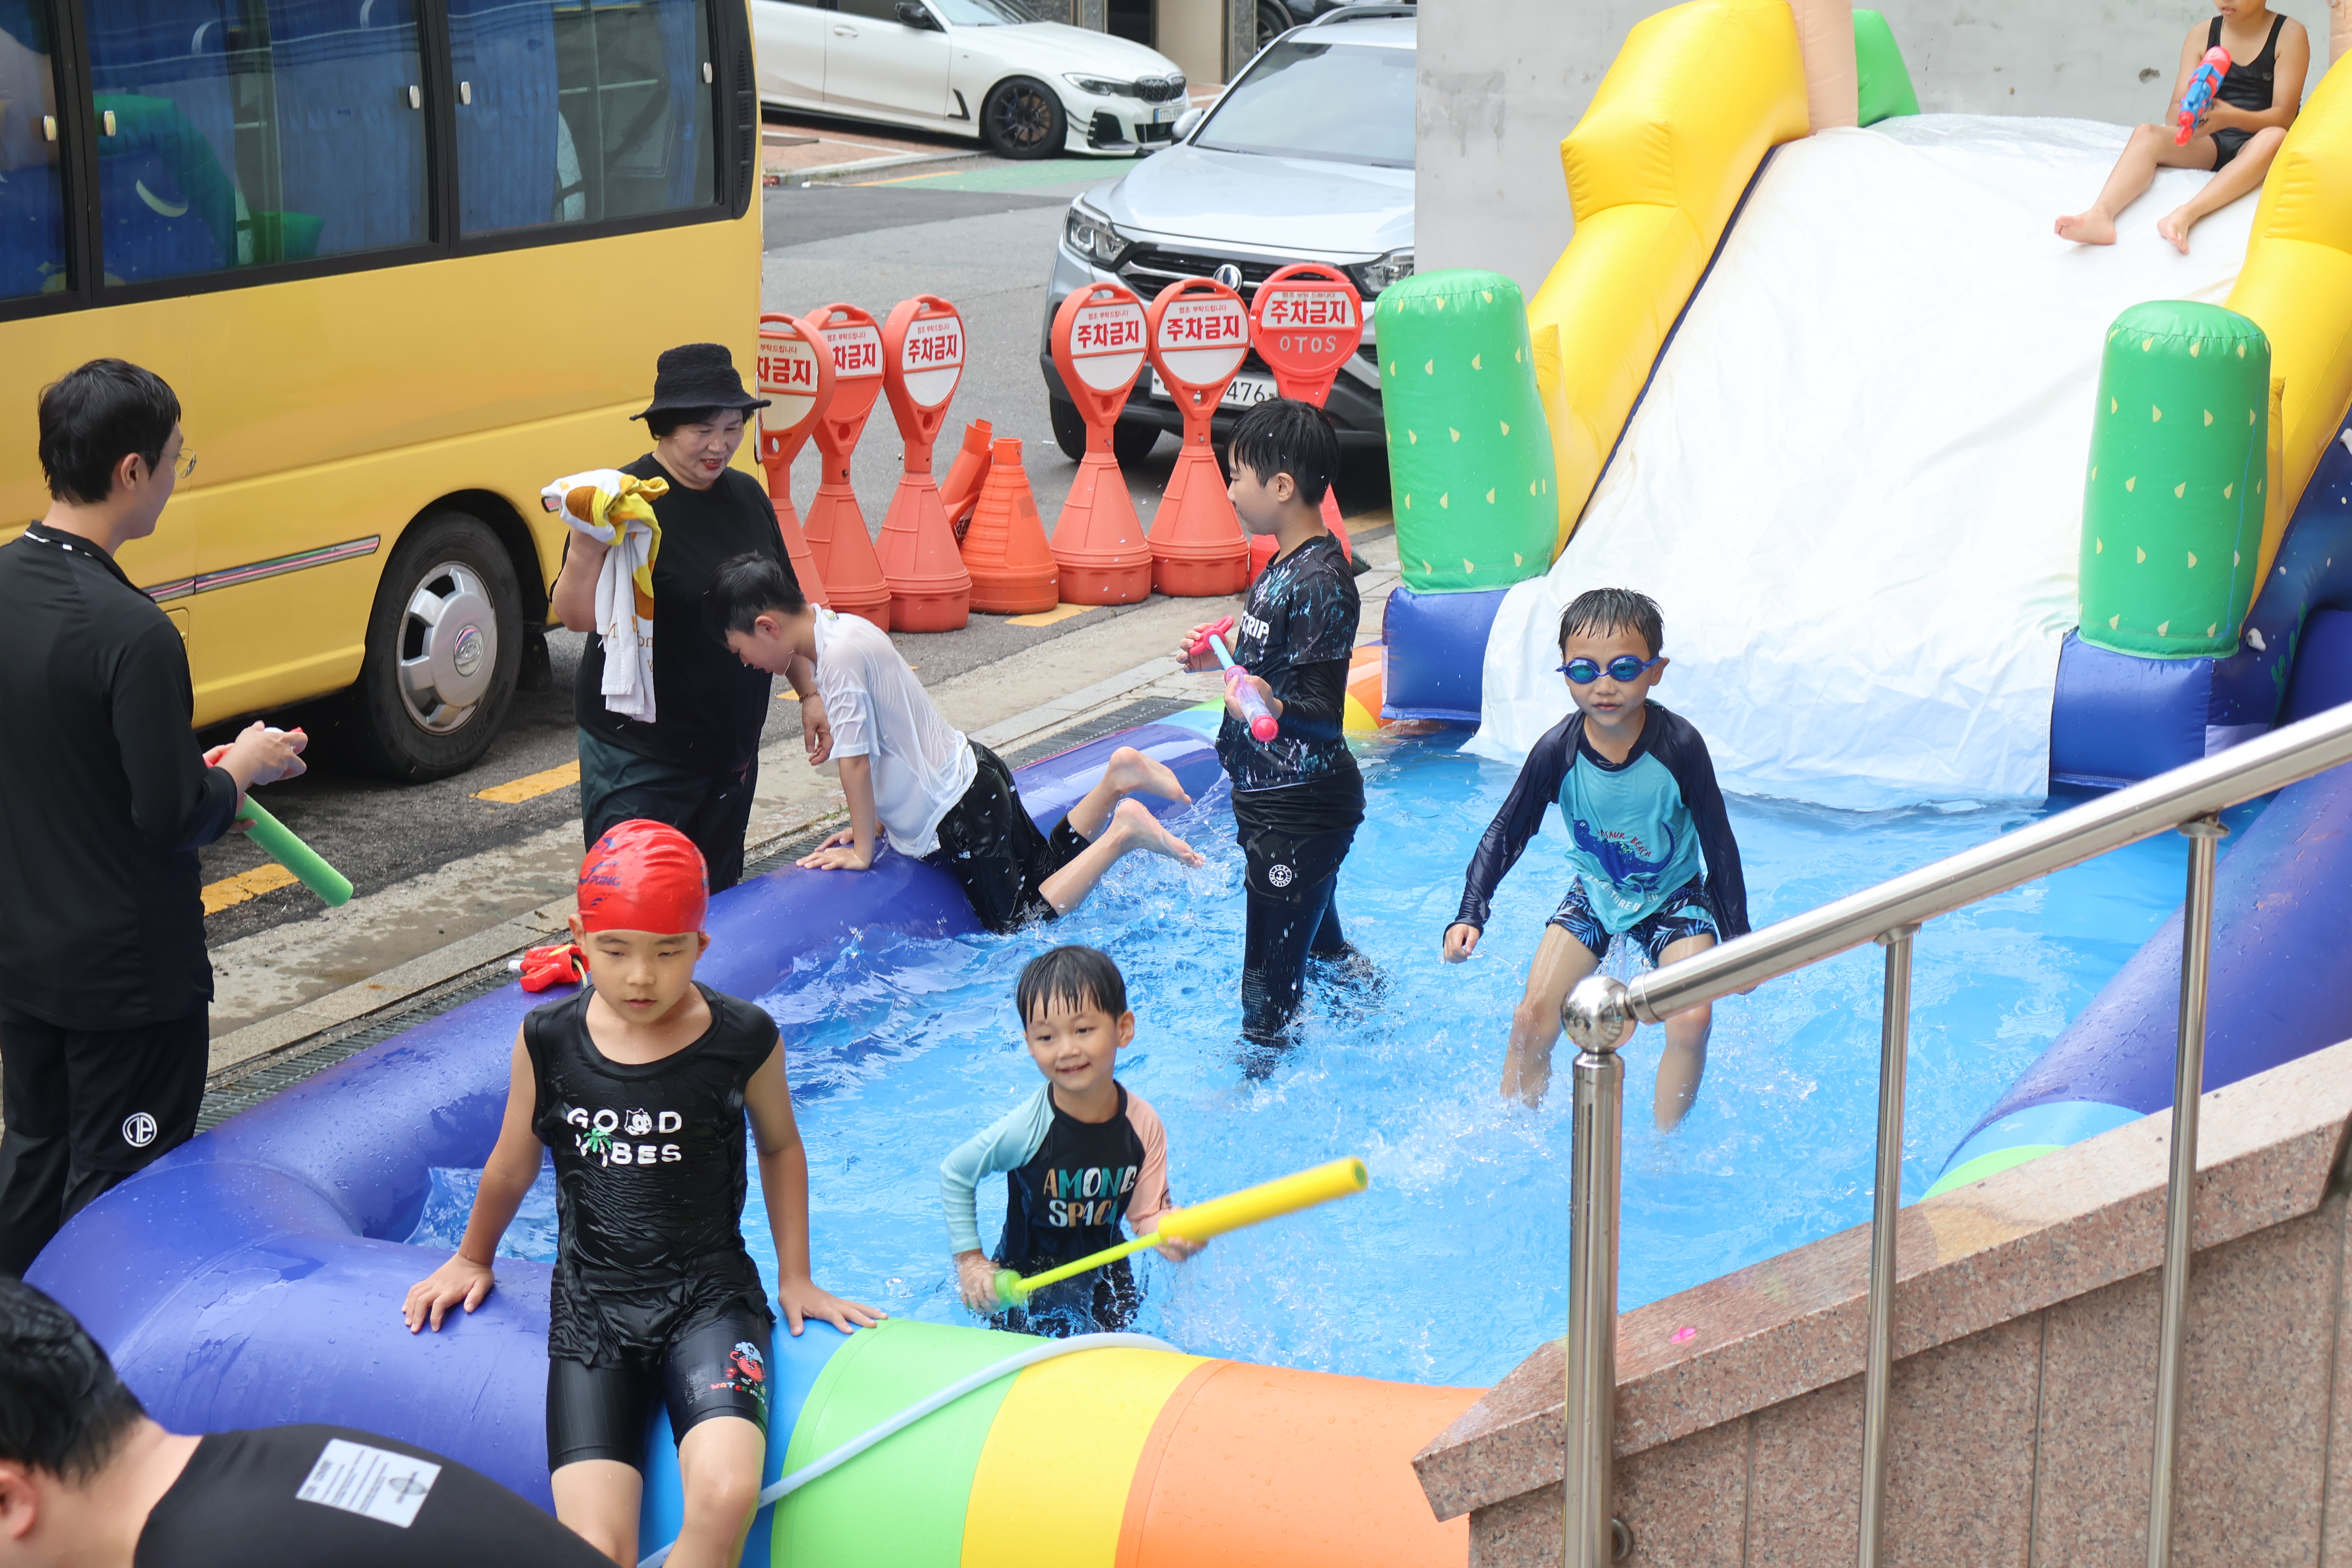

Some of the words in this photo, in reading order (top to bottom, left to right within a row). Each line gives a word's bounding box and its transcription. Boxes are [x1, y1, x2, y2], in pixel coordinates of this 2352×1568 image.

[1100, 310, 1129, 319] 부탁드립니다
[1193, 304, 1227, 313] 부탁드립니다
[1271, 301, 1345, 324] 주차금지
[839, 331, 866, 341] 부탁드립니다
[1078, 320, 1139, 348] 주차금지
[1167, 315, 1239, 342] 주차금지
[760, 344, 797, 354] 부탁드립니다
[908, 334, 957, 364] 주차금지
[1280, 335, 1337, 354] OTOS
[833, 343, 876, 370] 차금지
[757, 356, 811, 385] 차금지
[1226, 381, 1265, 403] 476
[1630, 837, 1651, 857] BEACH
[1271, 877, 1290, 886] MARINE
[1043, 1165, 1137, 1199] AMONG
